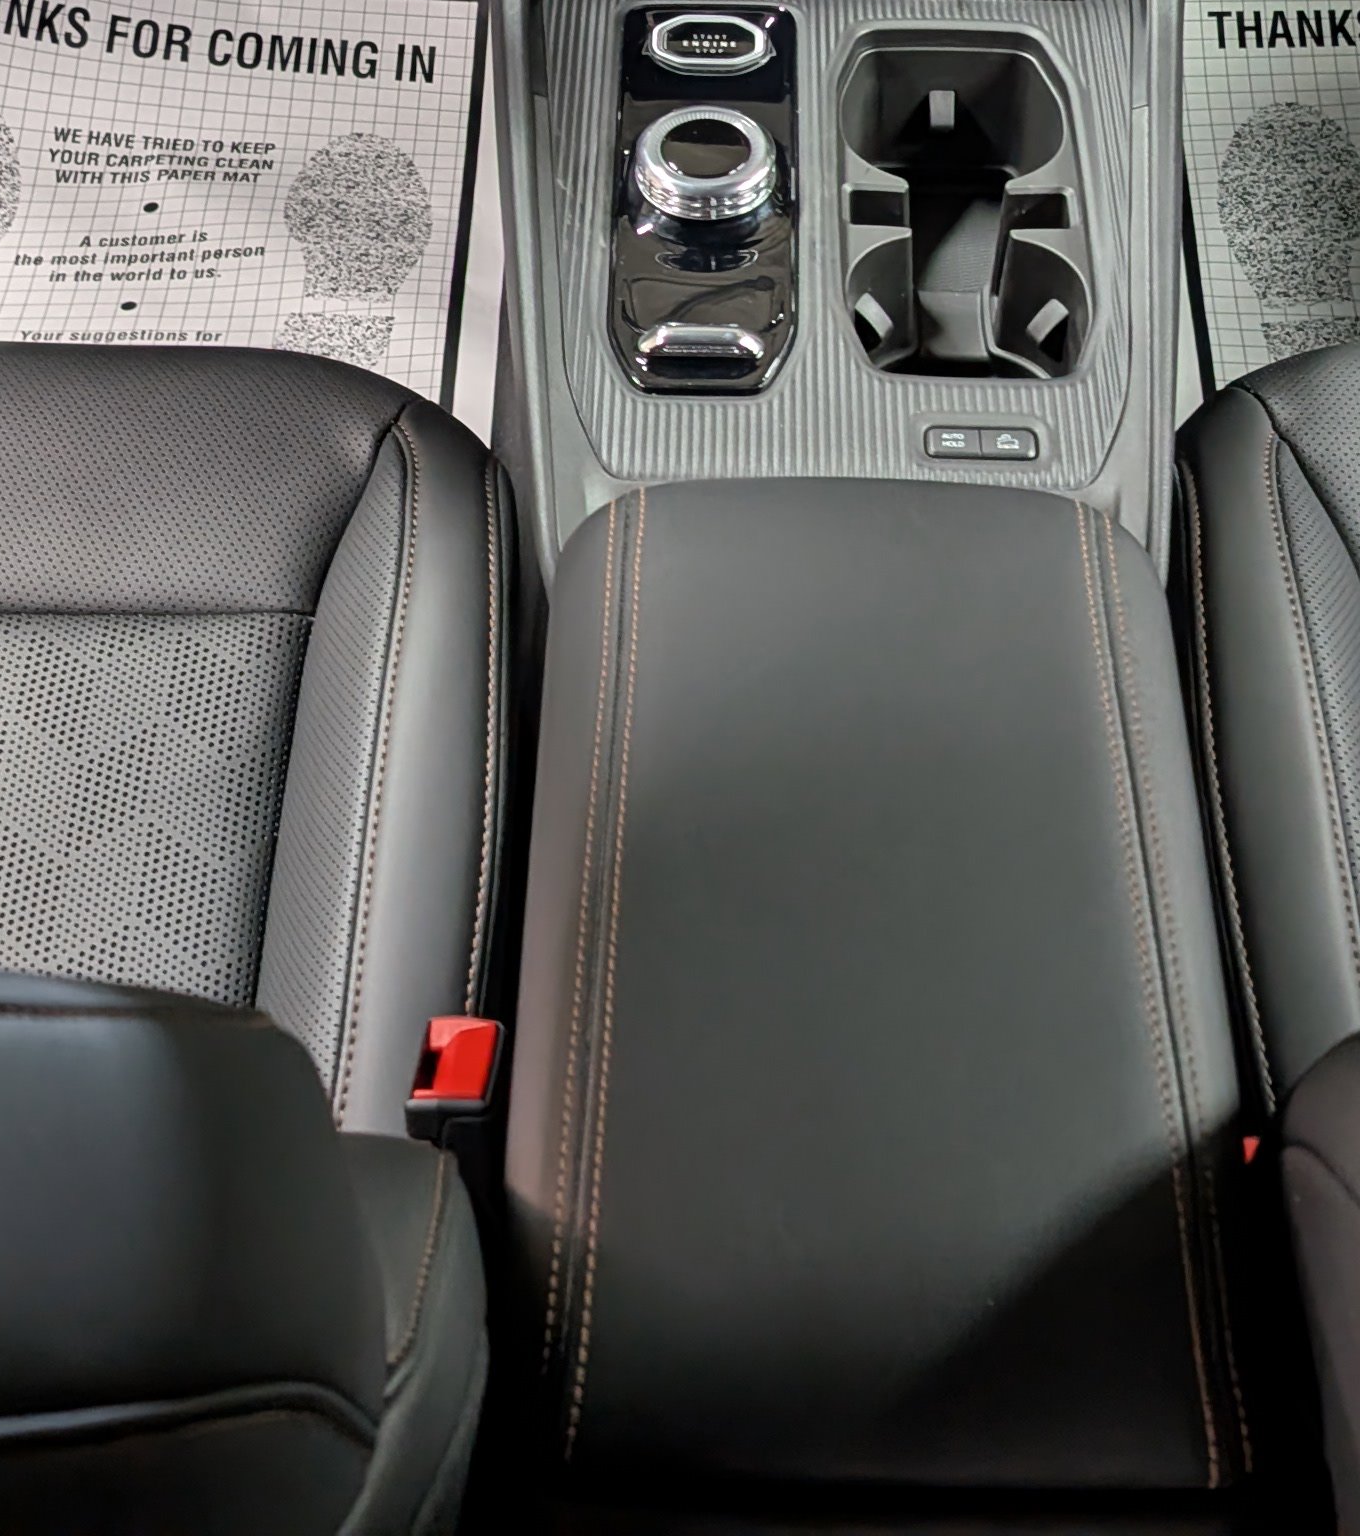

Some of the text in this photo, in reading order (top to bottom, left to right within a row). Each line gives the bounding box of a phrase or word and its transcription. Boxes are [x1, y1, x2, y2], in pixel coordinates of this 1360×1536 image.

[106, 15, 192, 62] FOR
[208, 29, 379, 79] COMING
[395, 43, 437, 84] IN
[681, 40, 737, 48] ENGINE
[54, 126, 276, 155] WE HAVE TRIED TO KEEP
[49, 148, 274, 170] YOUR CARPETING CLEAN
[55, 169, 261, 184] WITH THIS PAPER MAT
[79, 230, 208, 248] A customer is
[14, 246, 265, 267] the most important person
[49, 267, 222, 282] in the world to us.
[21, 329, 222, 342] Your suggestions for
[941, 432, 965, 440] AUTO
